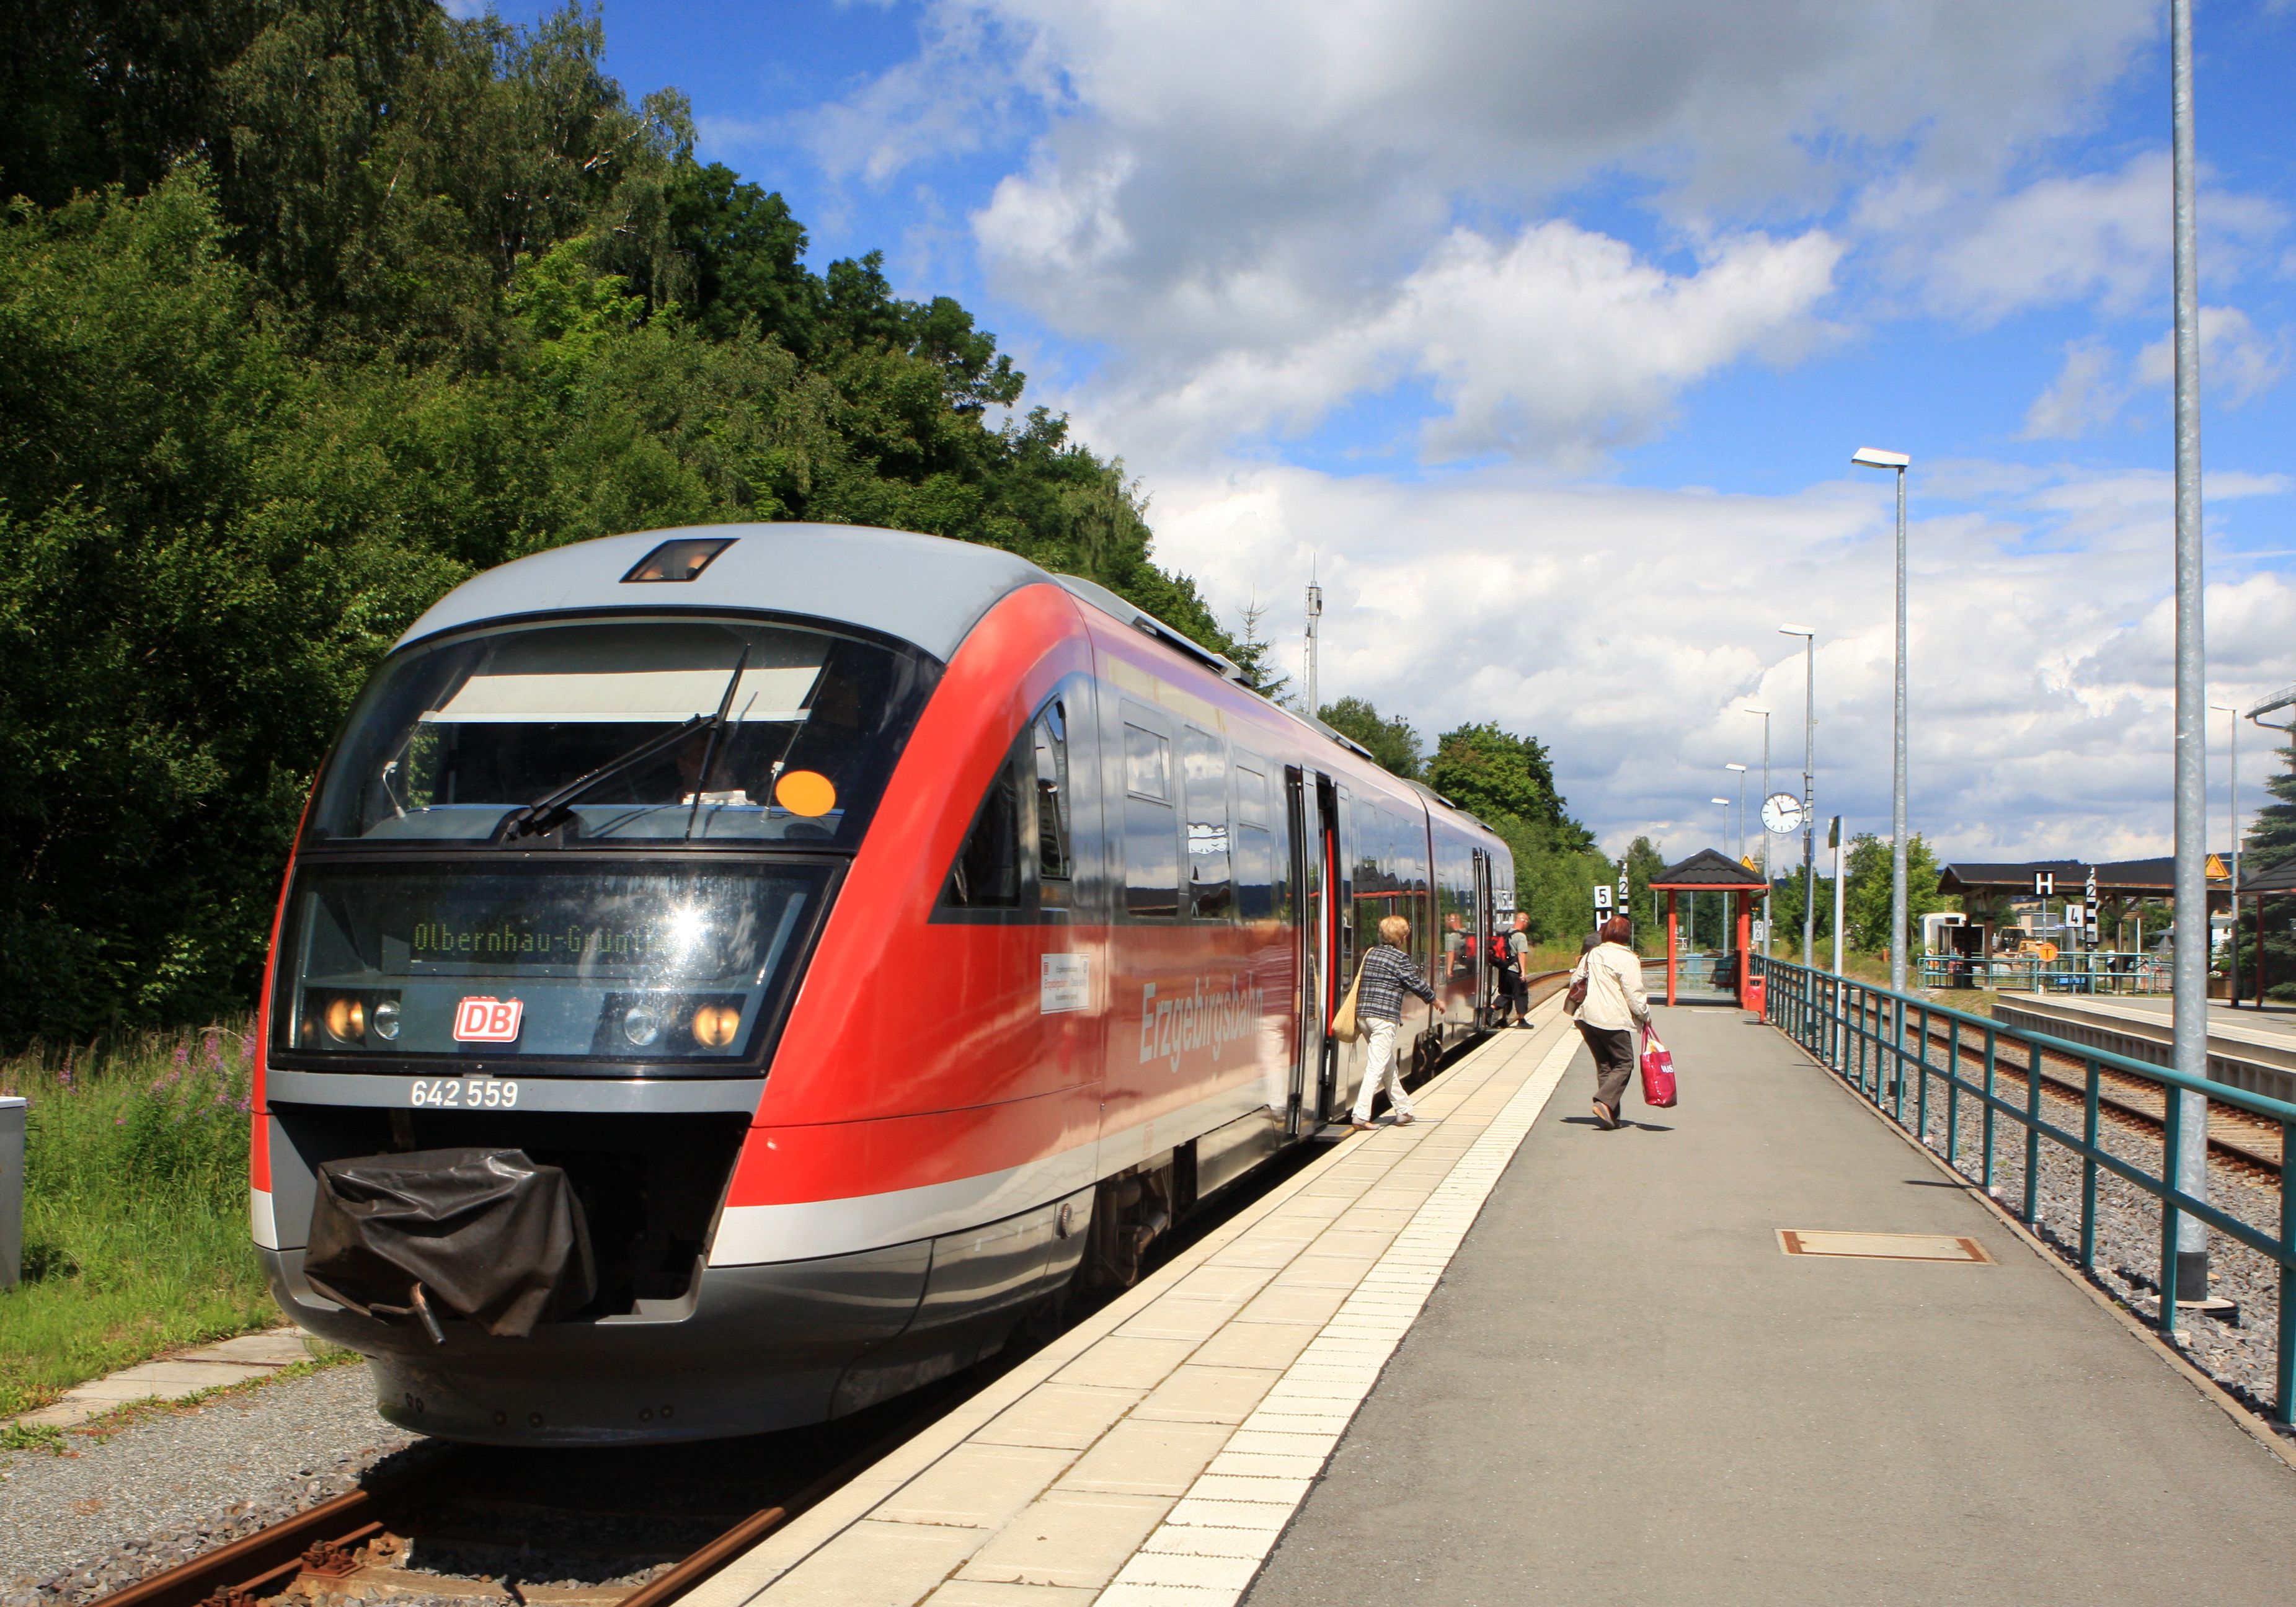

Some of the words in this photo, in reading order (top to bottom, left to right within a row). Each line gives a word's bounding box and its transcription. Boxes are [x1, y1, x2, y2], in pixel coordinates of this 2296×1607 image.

[1619, 881, 1628, 895] 2
[2036, 873, 2053, 895] H
[2086, 883, 2096, 897] 2
[1598, 888, 1607, 905] 5
[2070, 908, 2078, 924] 4
[464, 1004, 512, 1034] DB
[1140, 971, 1264, 1074] Erzgebirgsbahn
[411, 1080, 461, 1107] 642
[466, 1081, 518, 1107] 559
